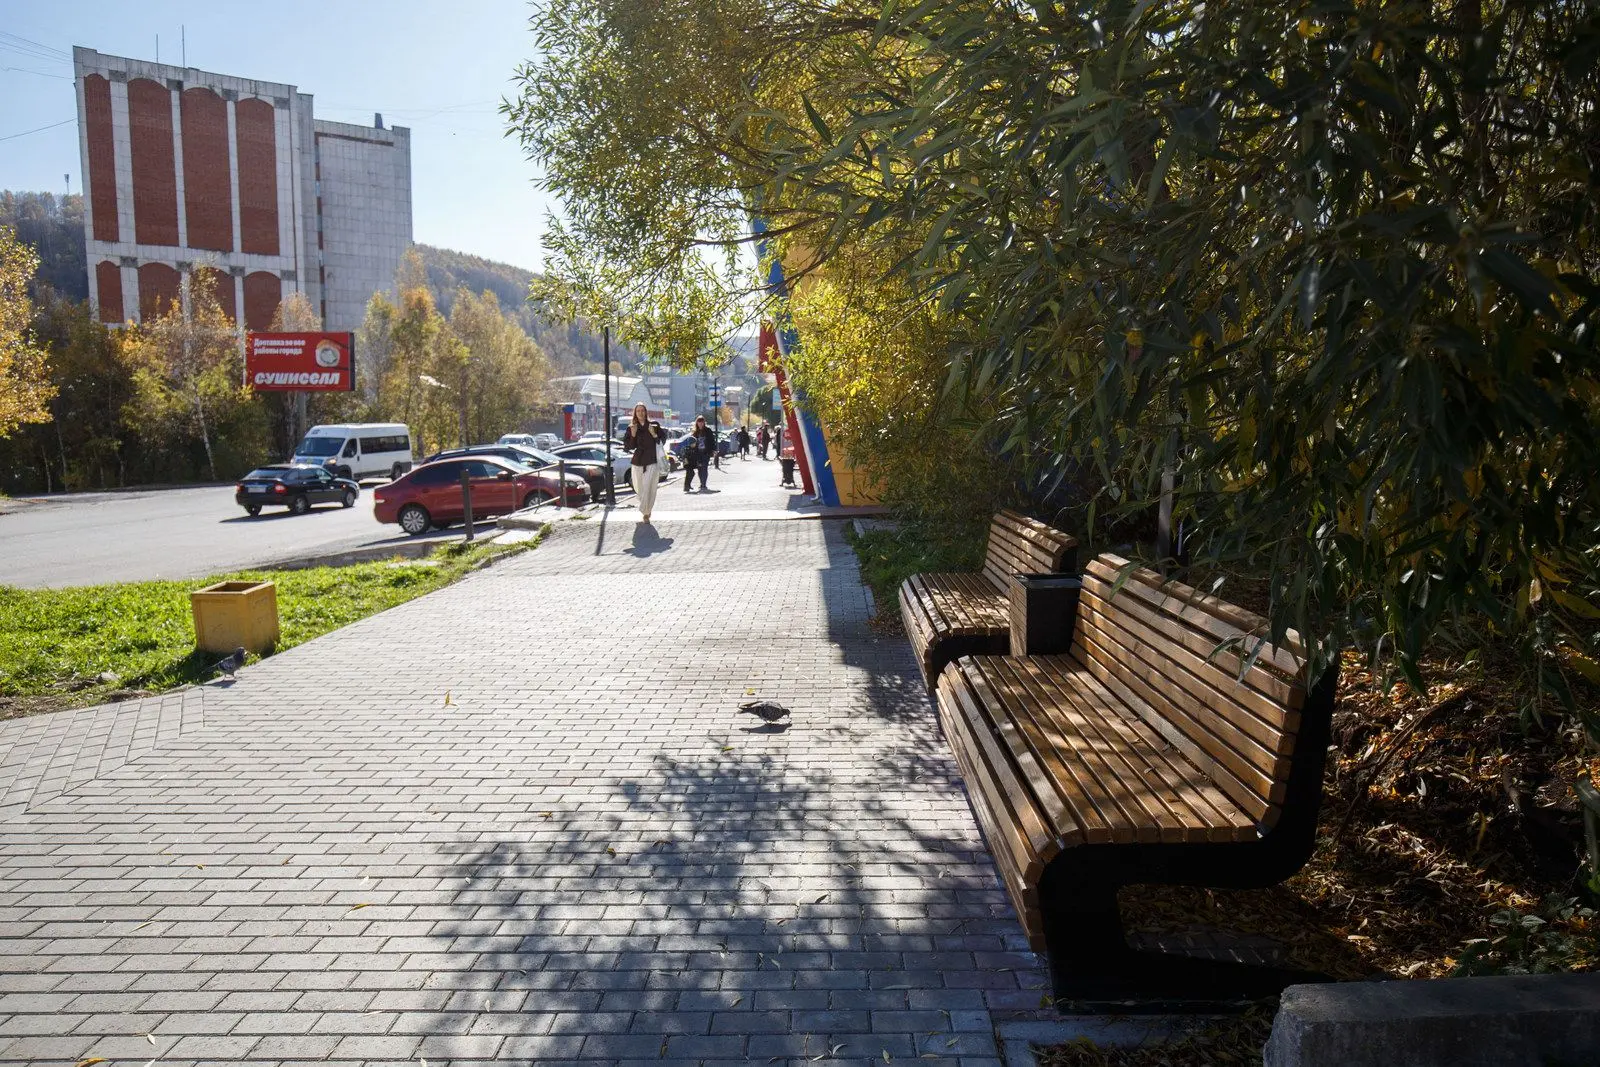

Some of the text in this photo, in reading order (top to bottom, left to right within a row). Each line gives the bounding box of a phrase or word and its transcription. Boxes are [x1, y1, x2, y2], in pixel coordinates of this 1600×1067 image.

[254, 338, 284, 347] Доставка
[254, 347, 303, 356] районы города
